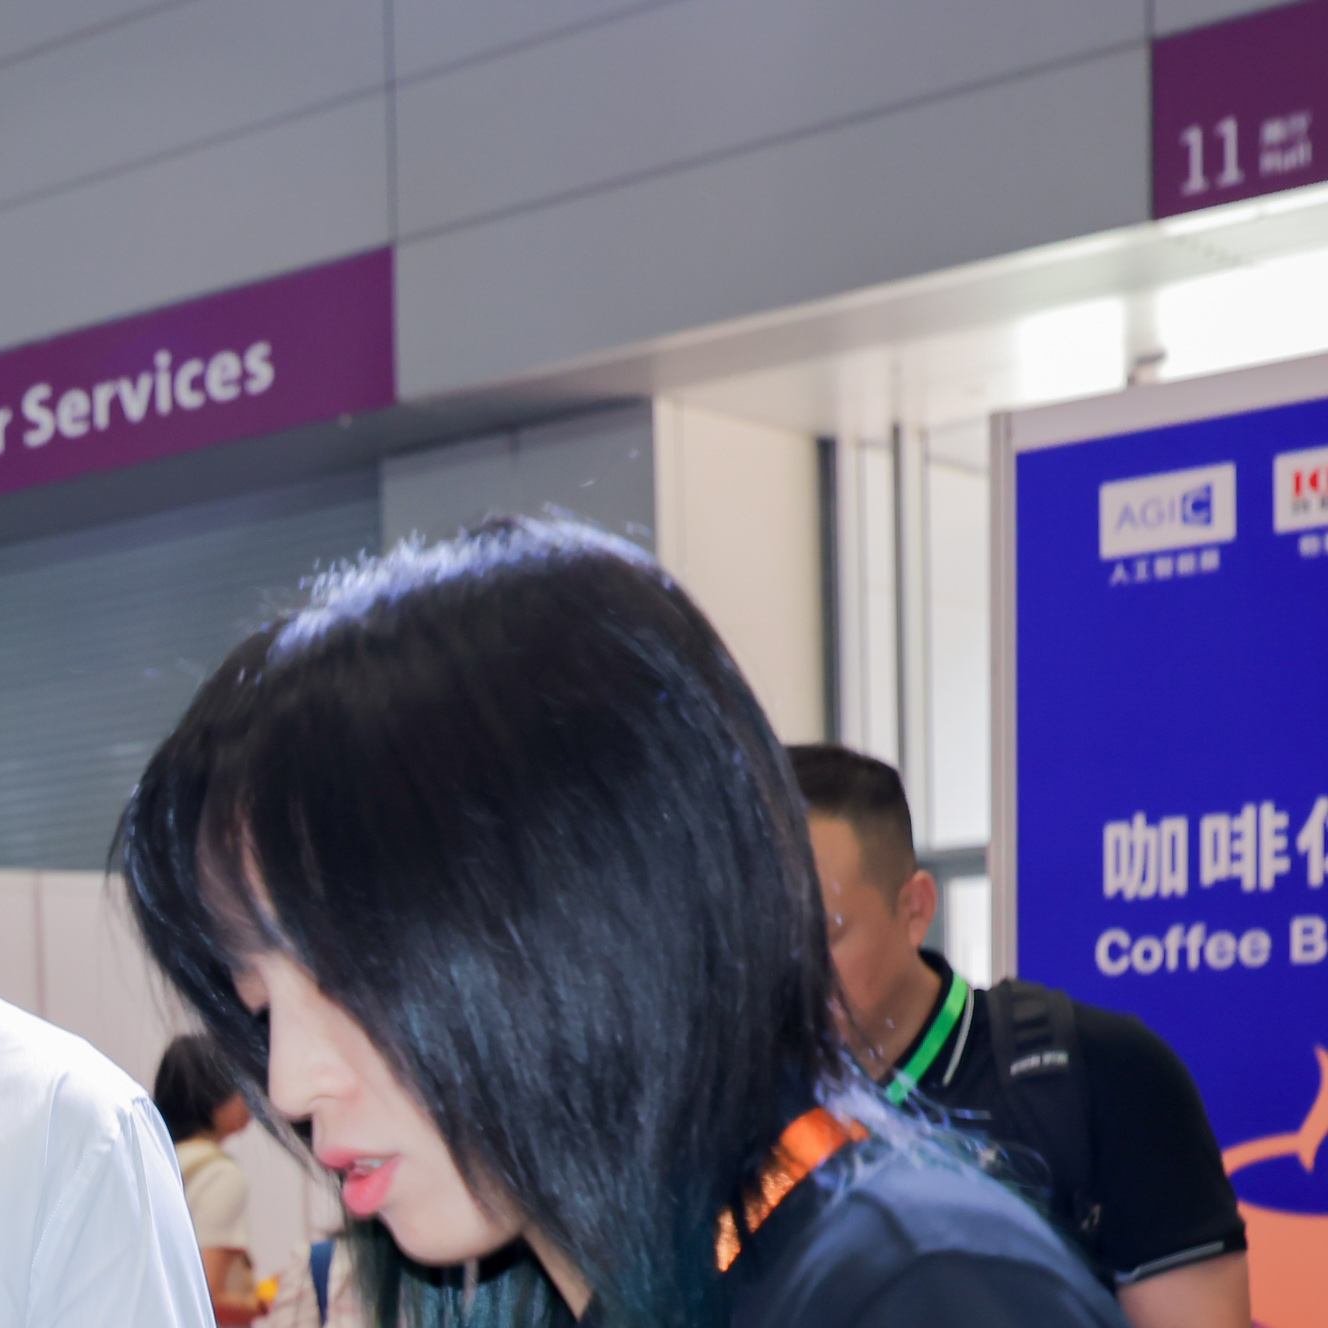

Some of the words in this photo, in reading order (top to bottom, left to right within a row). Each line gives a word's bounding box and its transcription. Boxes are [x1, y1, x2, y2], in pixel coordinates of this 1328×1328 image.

[1178, 113, 1244, 197] 11
[21, 341, 275, 448] Services
[1095, 921, 1272, 977] Coffee
